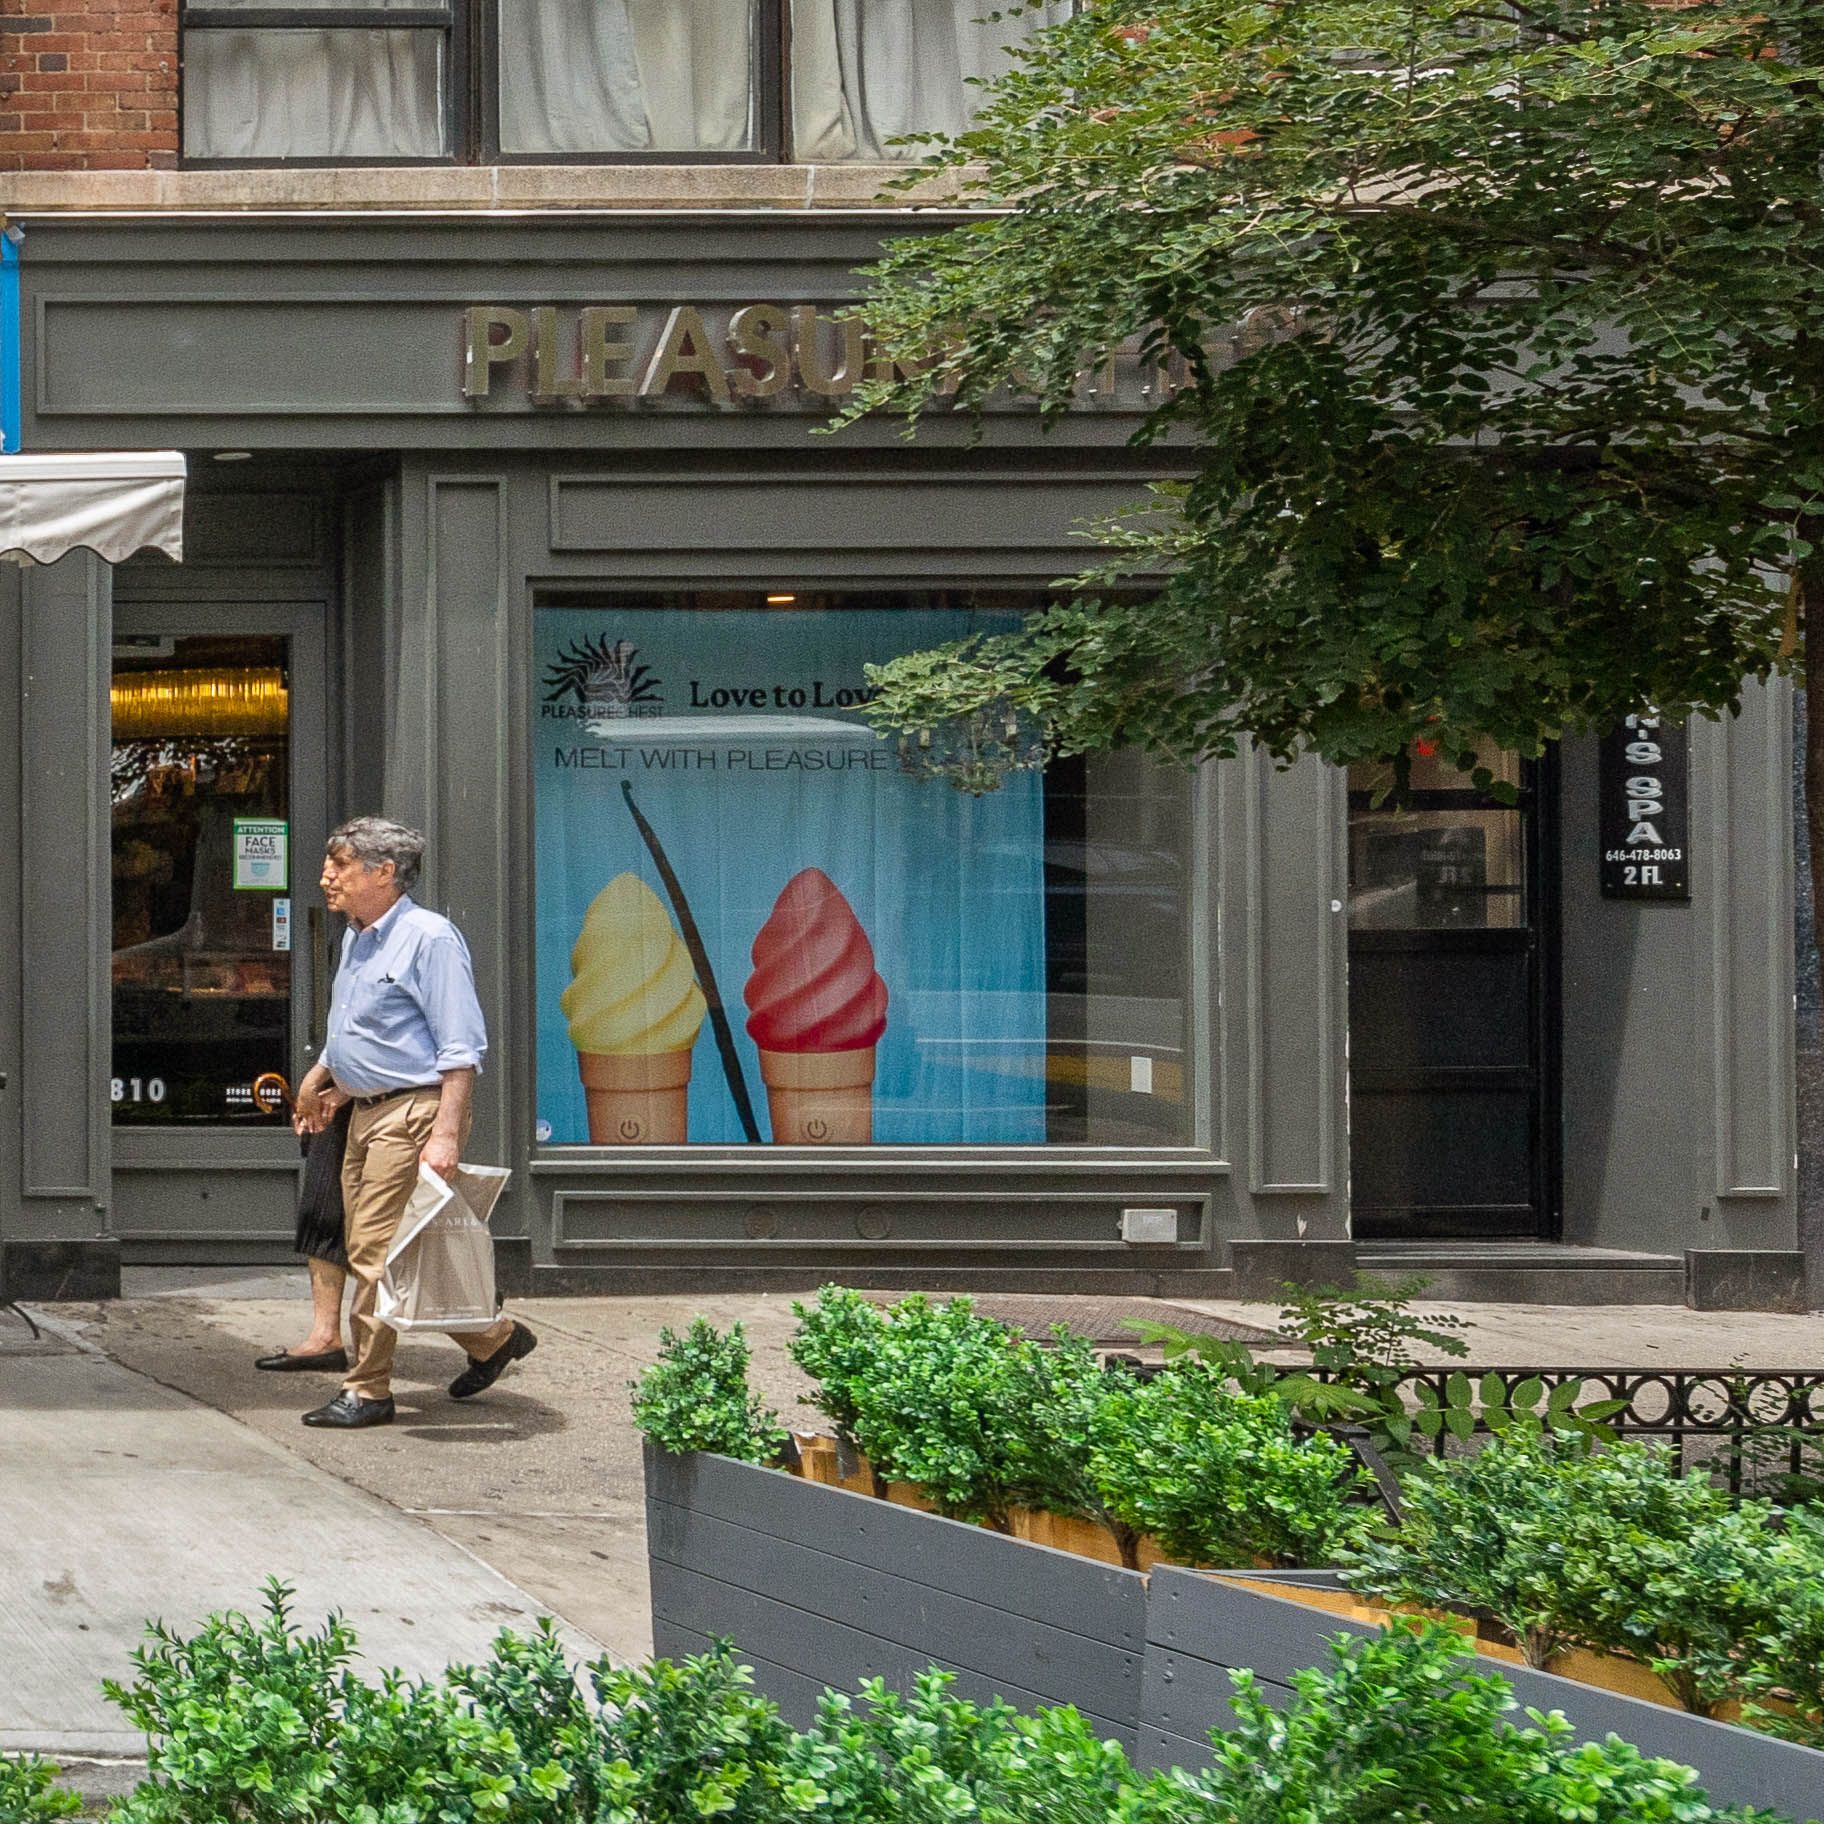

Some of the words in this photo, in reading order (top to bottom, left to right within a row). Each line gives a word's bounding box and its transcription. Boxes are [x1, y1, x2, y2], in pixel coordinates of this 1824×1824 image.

[690, 681, 767, 709] Love
[774, 684, 807, 709] to
[555, 747, 633, 771] MELT
[641, 748, 716, 771] WITH
[728, 749, 887, 771] PLEASURE
[1625, 776, 1664, 845] SPA
[237, 826, 286, 834] ATTENTION
[245, 836, 277, 847] FACE
[1605, 849, 1682, 862] 646-478-8063
[1623, 866, 1637, 885] 2
[1641, 866, 1664, 885] FL
[111, 1078, 165, 1102] 810
